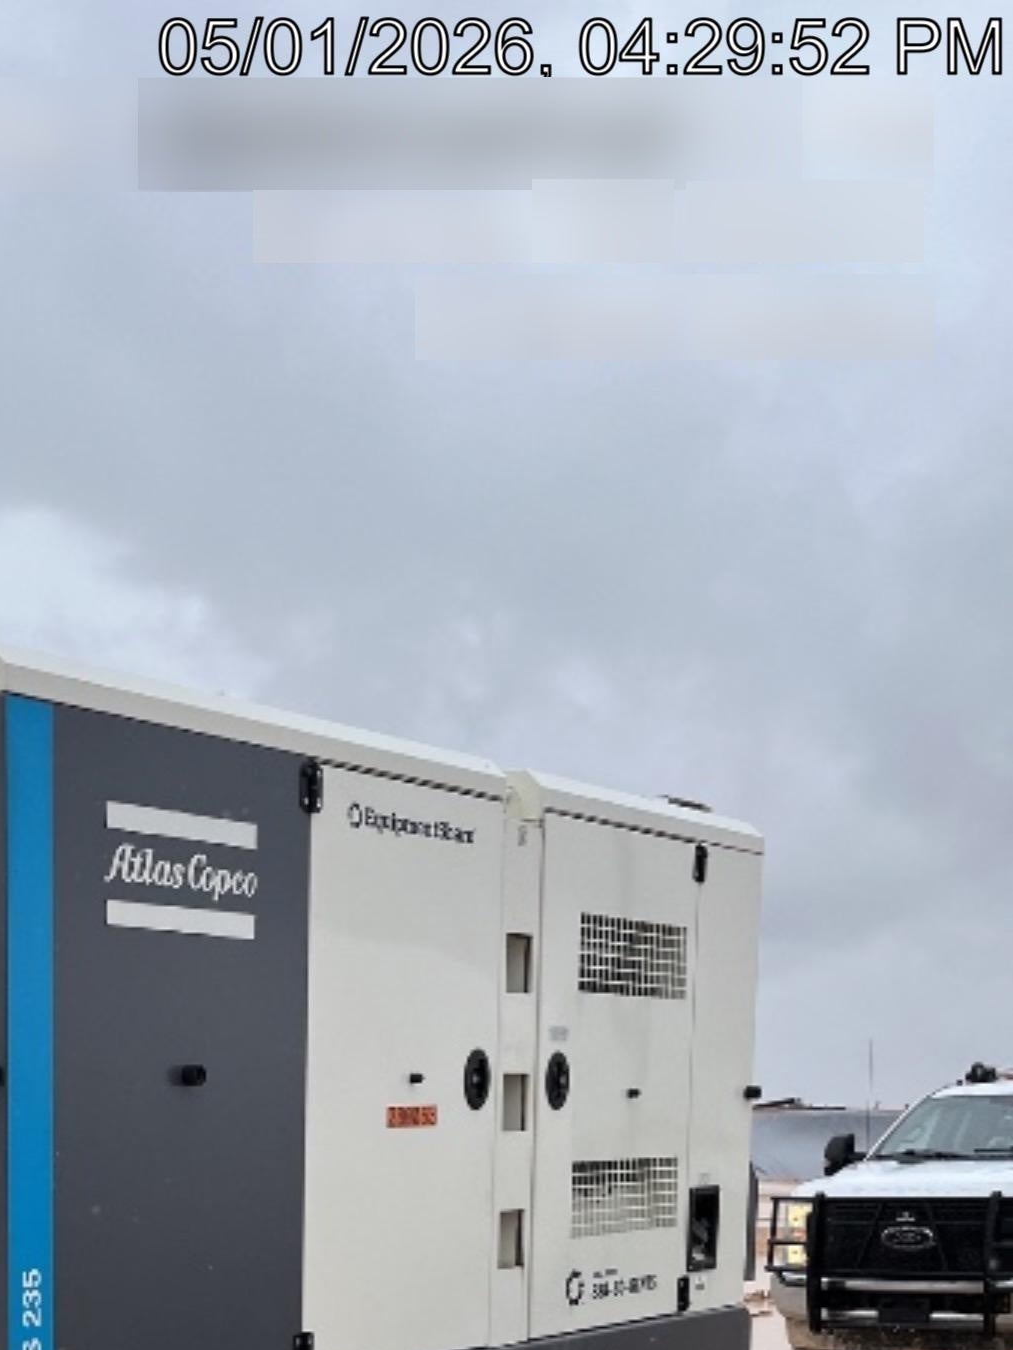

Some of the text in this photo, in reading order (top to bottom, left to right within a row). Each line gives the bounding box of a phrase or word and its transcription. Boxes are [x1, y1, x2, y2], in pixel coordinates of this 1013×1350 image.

[103, 843, 258, 902] Atlas Copco
[21, 1268, 43, 1328] 235
